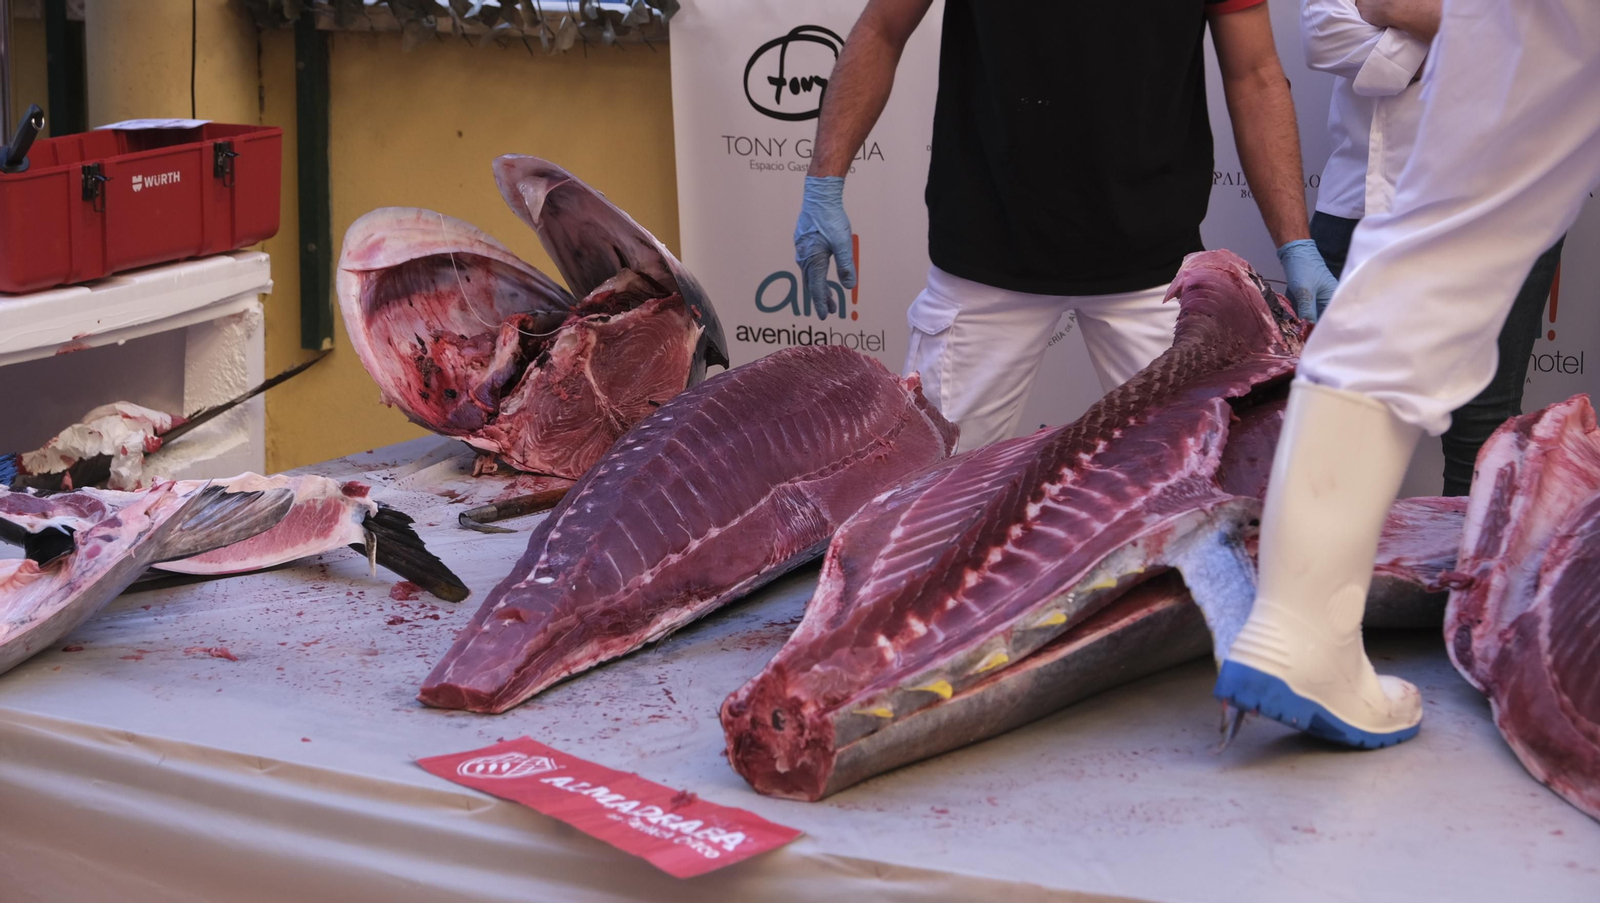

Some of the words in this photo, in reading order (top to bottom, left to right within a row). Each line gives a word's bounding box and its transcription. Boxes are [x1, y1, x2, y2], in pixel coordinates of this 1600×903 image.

[721, 135, 787, 157] TONY
[749, 159, 785, 172] Espacio
[143, 170, 181, 188] WÜRTH
[539, 776, 747, 852] ALMADRABA
